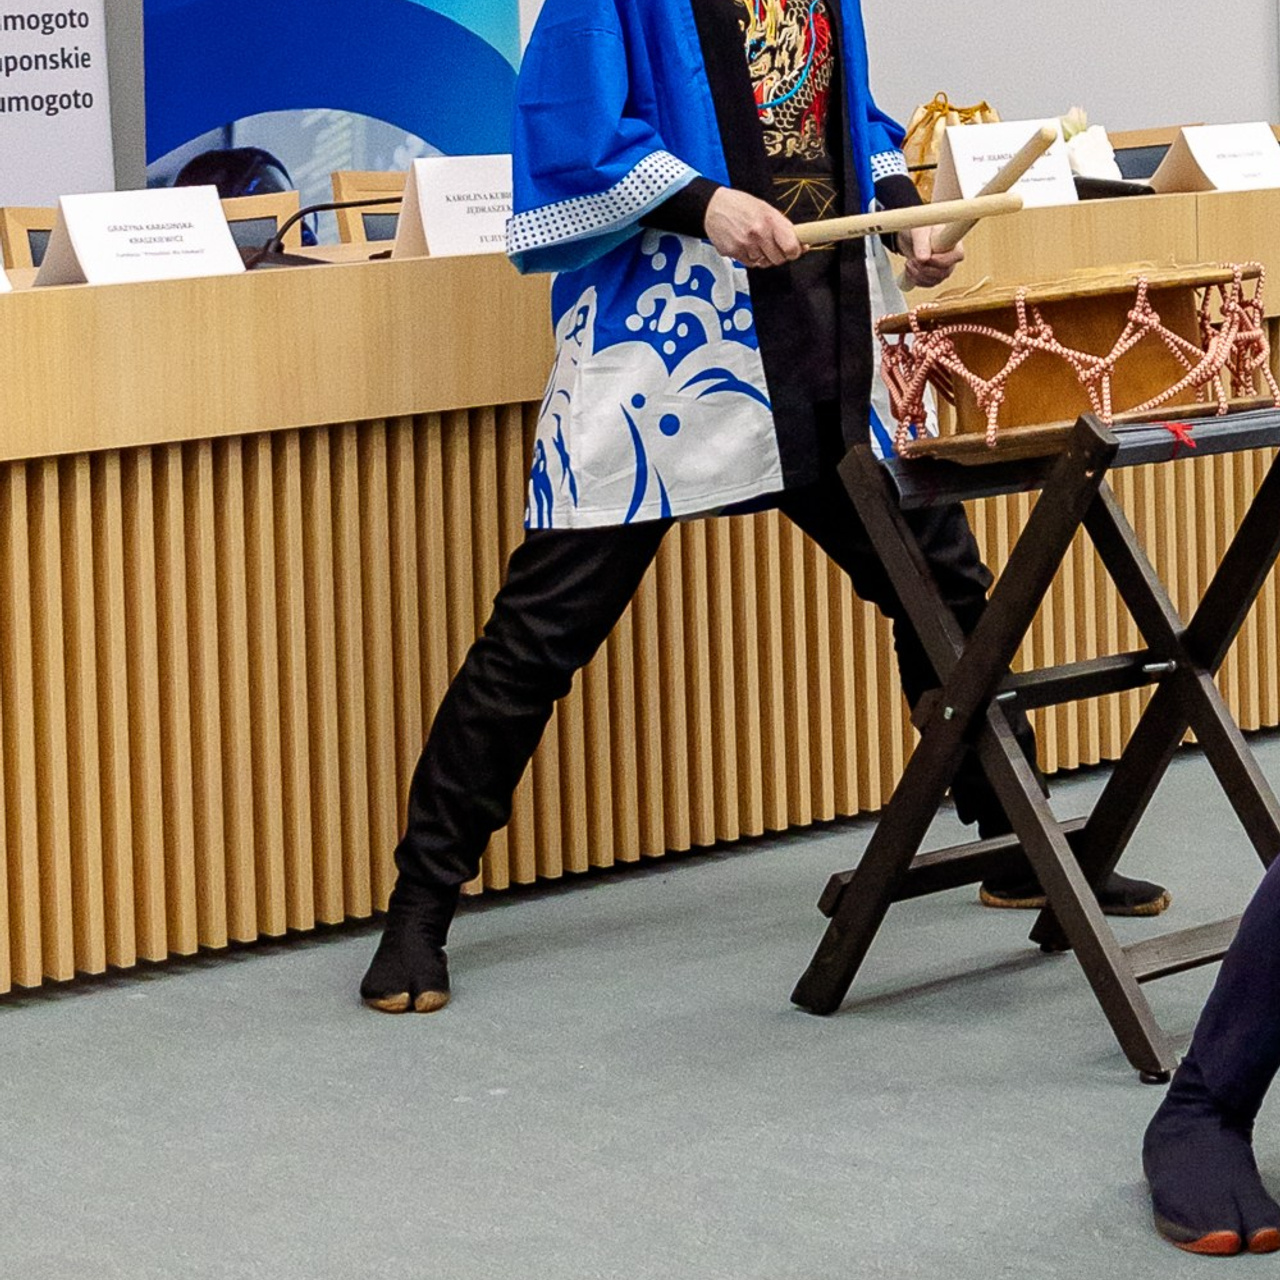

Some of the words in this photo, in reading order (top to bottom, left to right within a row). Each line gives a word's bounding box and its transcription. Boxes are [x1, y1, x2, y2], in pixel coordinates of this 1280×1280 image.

[0, 8, 90, 36] mogoto
[0, 46, 92, 77] ponskie
[445, 193, 488, 202] KAROLINA
[488, 192, 511, 200] KUBI
